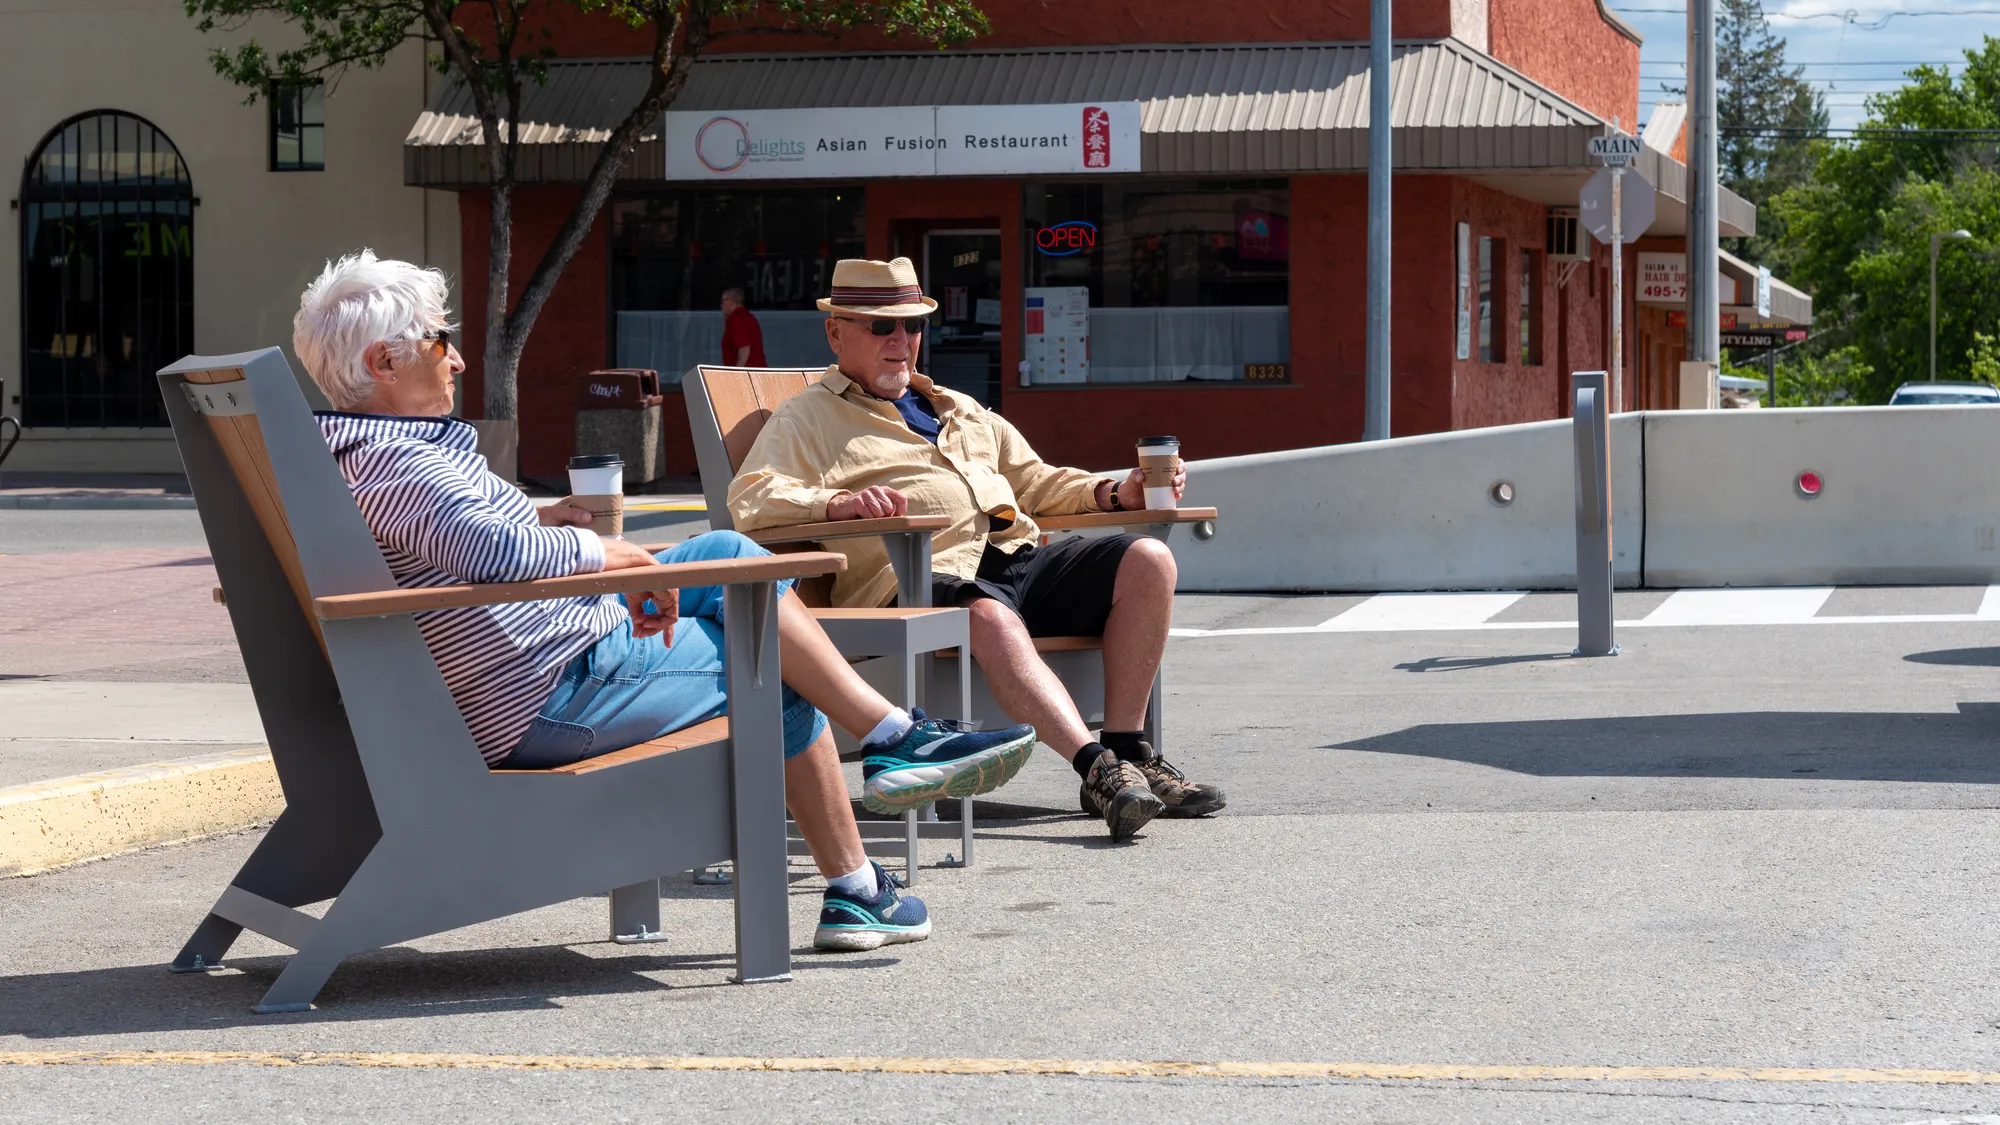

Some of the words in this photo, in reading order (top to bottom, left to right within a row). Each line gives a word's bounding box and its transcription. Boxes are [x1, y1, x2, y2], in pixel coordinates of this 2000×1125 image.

[816, 136, 867, 152] Asian
[885, 135, 947, 151] Fusion
[965, 133, 1069, 149] Restaurant
[1593, 138, 1641, 154] MAIN
[1036, 227, 1096, 248] OPEN
[954, 251, 979, 267] 8323
[1644, 272, 1670, 282] HAIR
[1248, 364, 1285, 380] 8323
